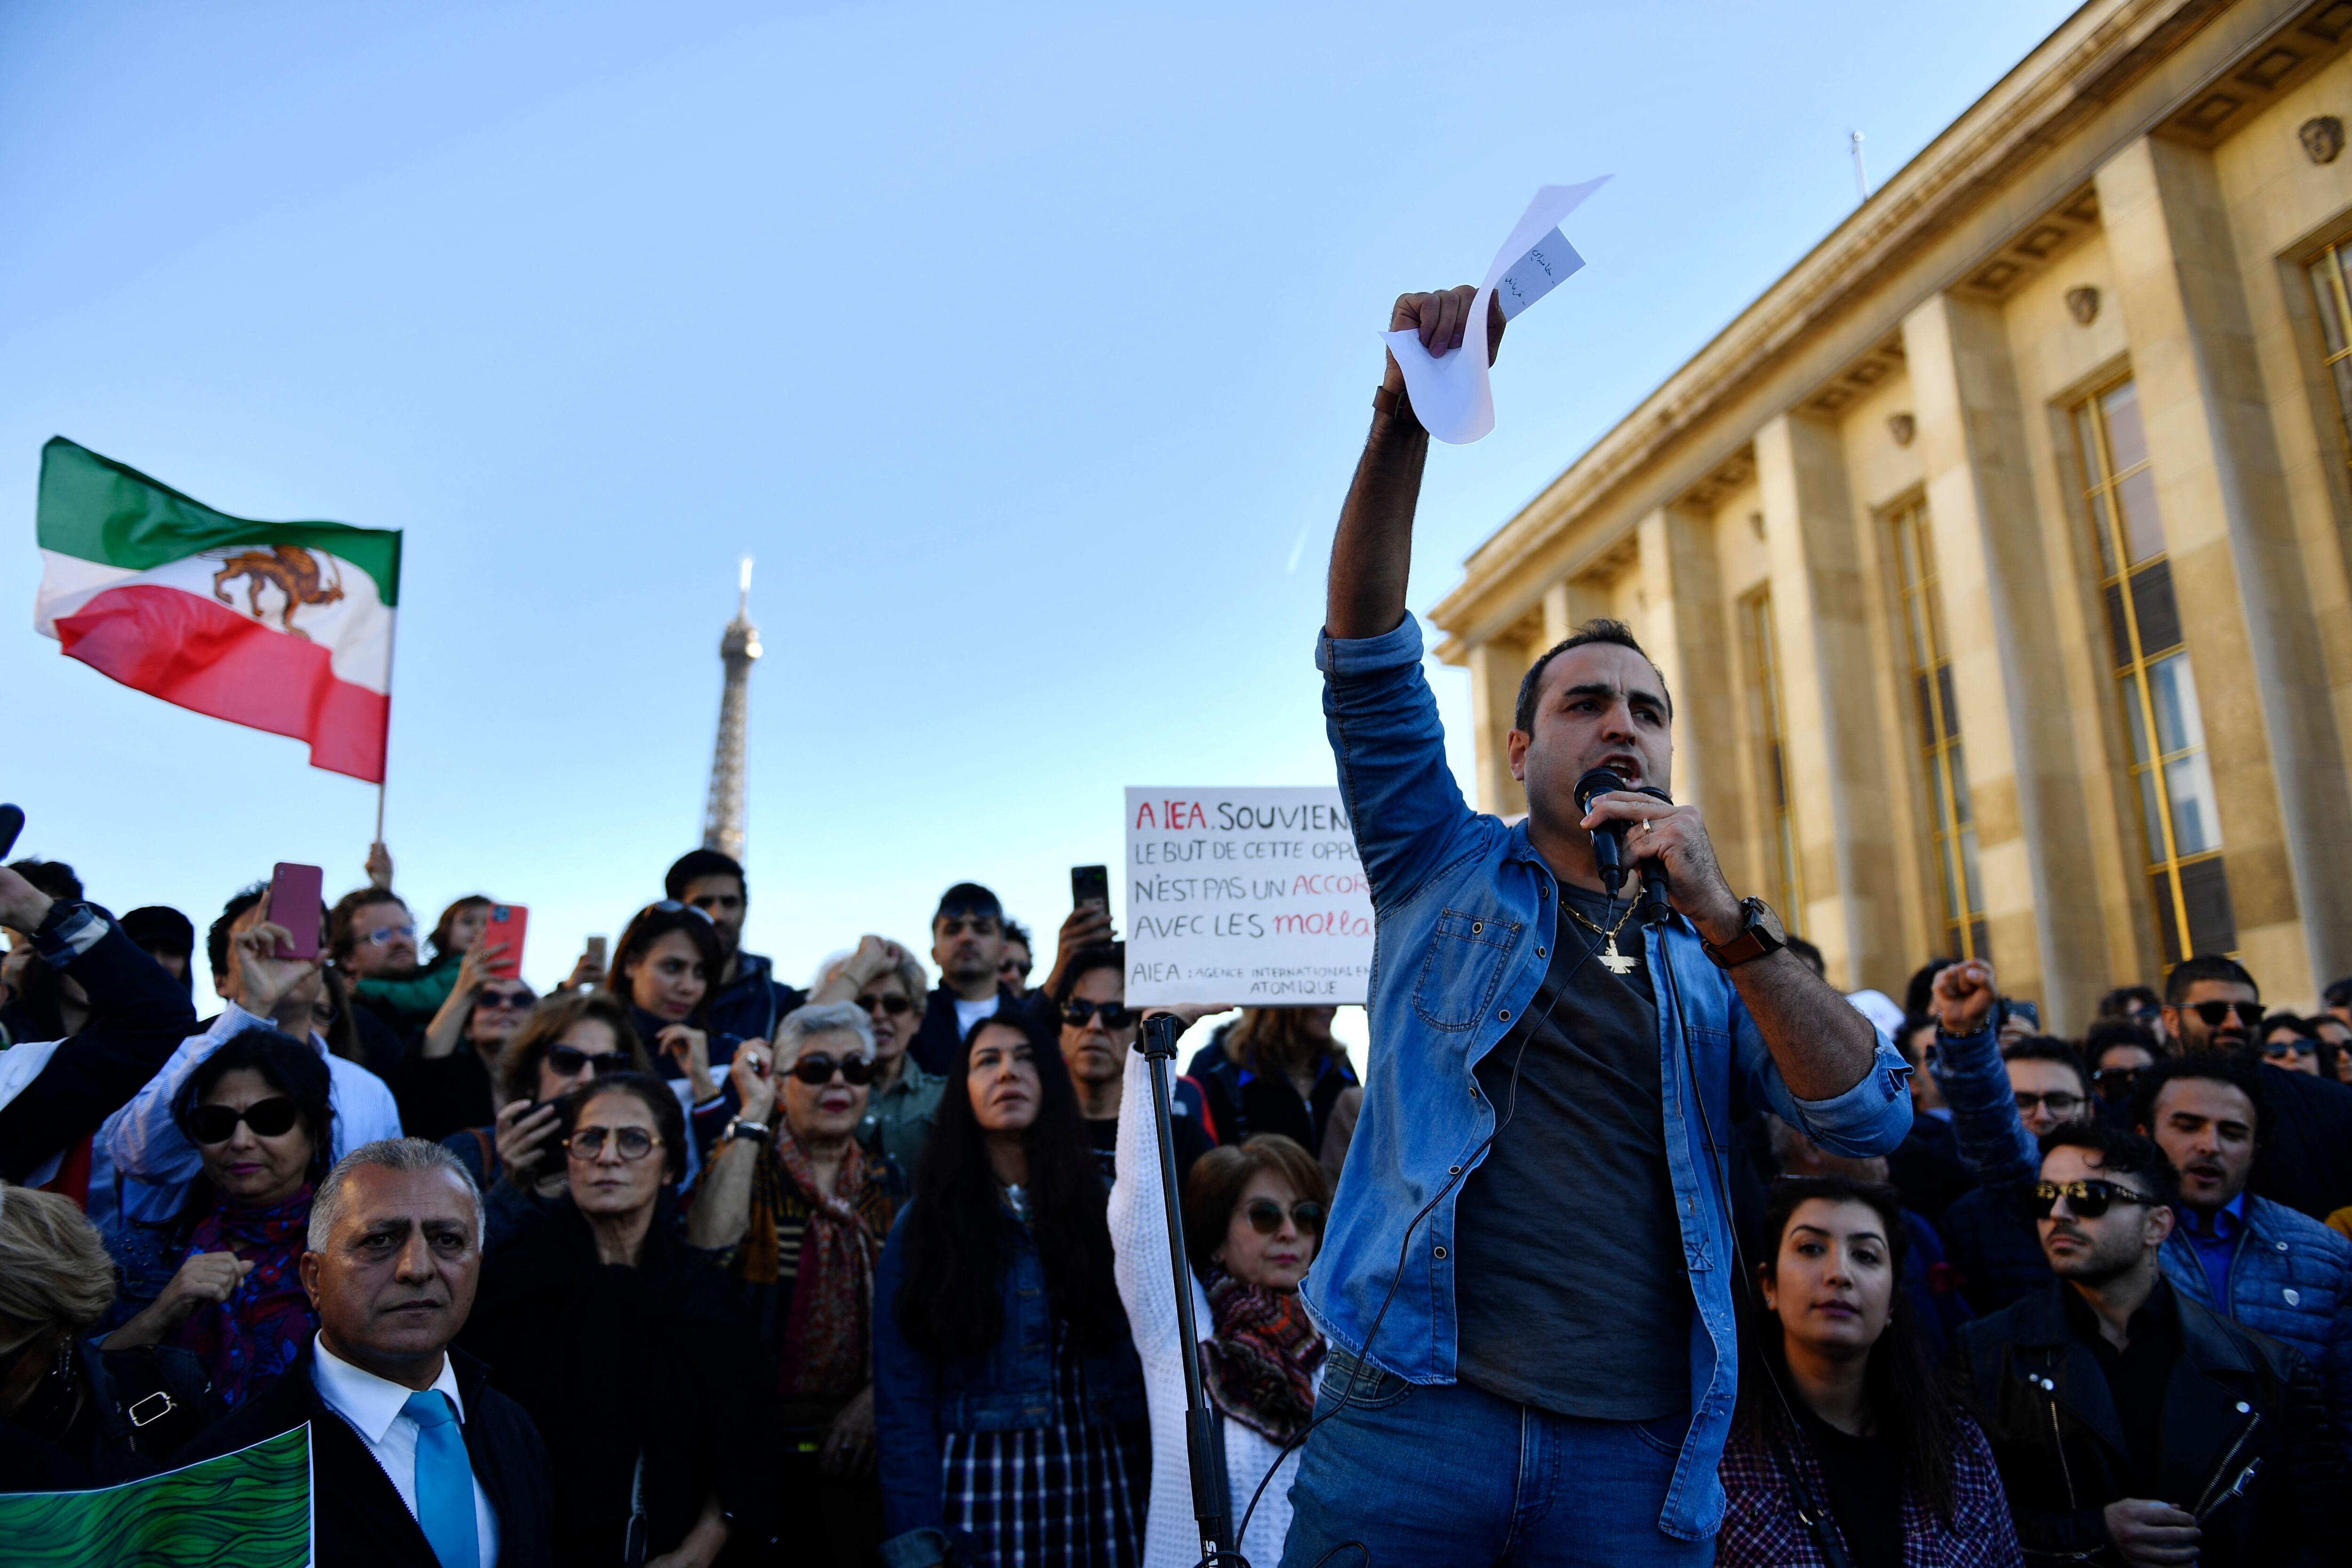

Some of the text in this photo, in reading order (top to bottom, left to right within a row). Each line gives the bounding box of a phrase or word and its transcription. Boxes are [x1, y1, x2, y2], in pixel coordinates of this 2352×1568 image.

[1136, 843, 1156, 864] LE
[1163, 840, 1207, 863] BUT
[1213, 841, 1237, 860] DE
[1244, 841, 1303, 859] CETTE
[1135, 873, 1371, 903] N'EST PAS UN ACCOR
[1134, 915, 1204, 940] AVEC
[1215, 913, 1264, 938] LES
[1131, 963, 1181, 986] AIEA
[1195, 967, 1244, 979] AGENCE
[1249, 980, 1338, 995] ATOMIQUE
[1426, 1188, 1448, 1210] PROFESSIONAL
